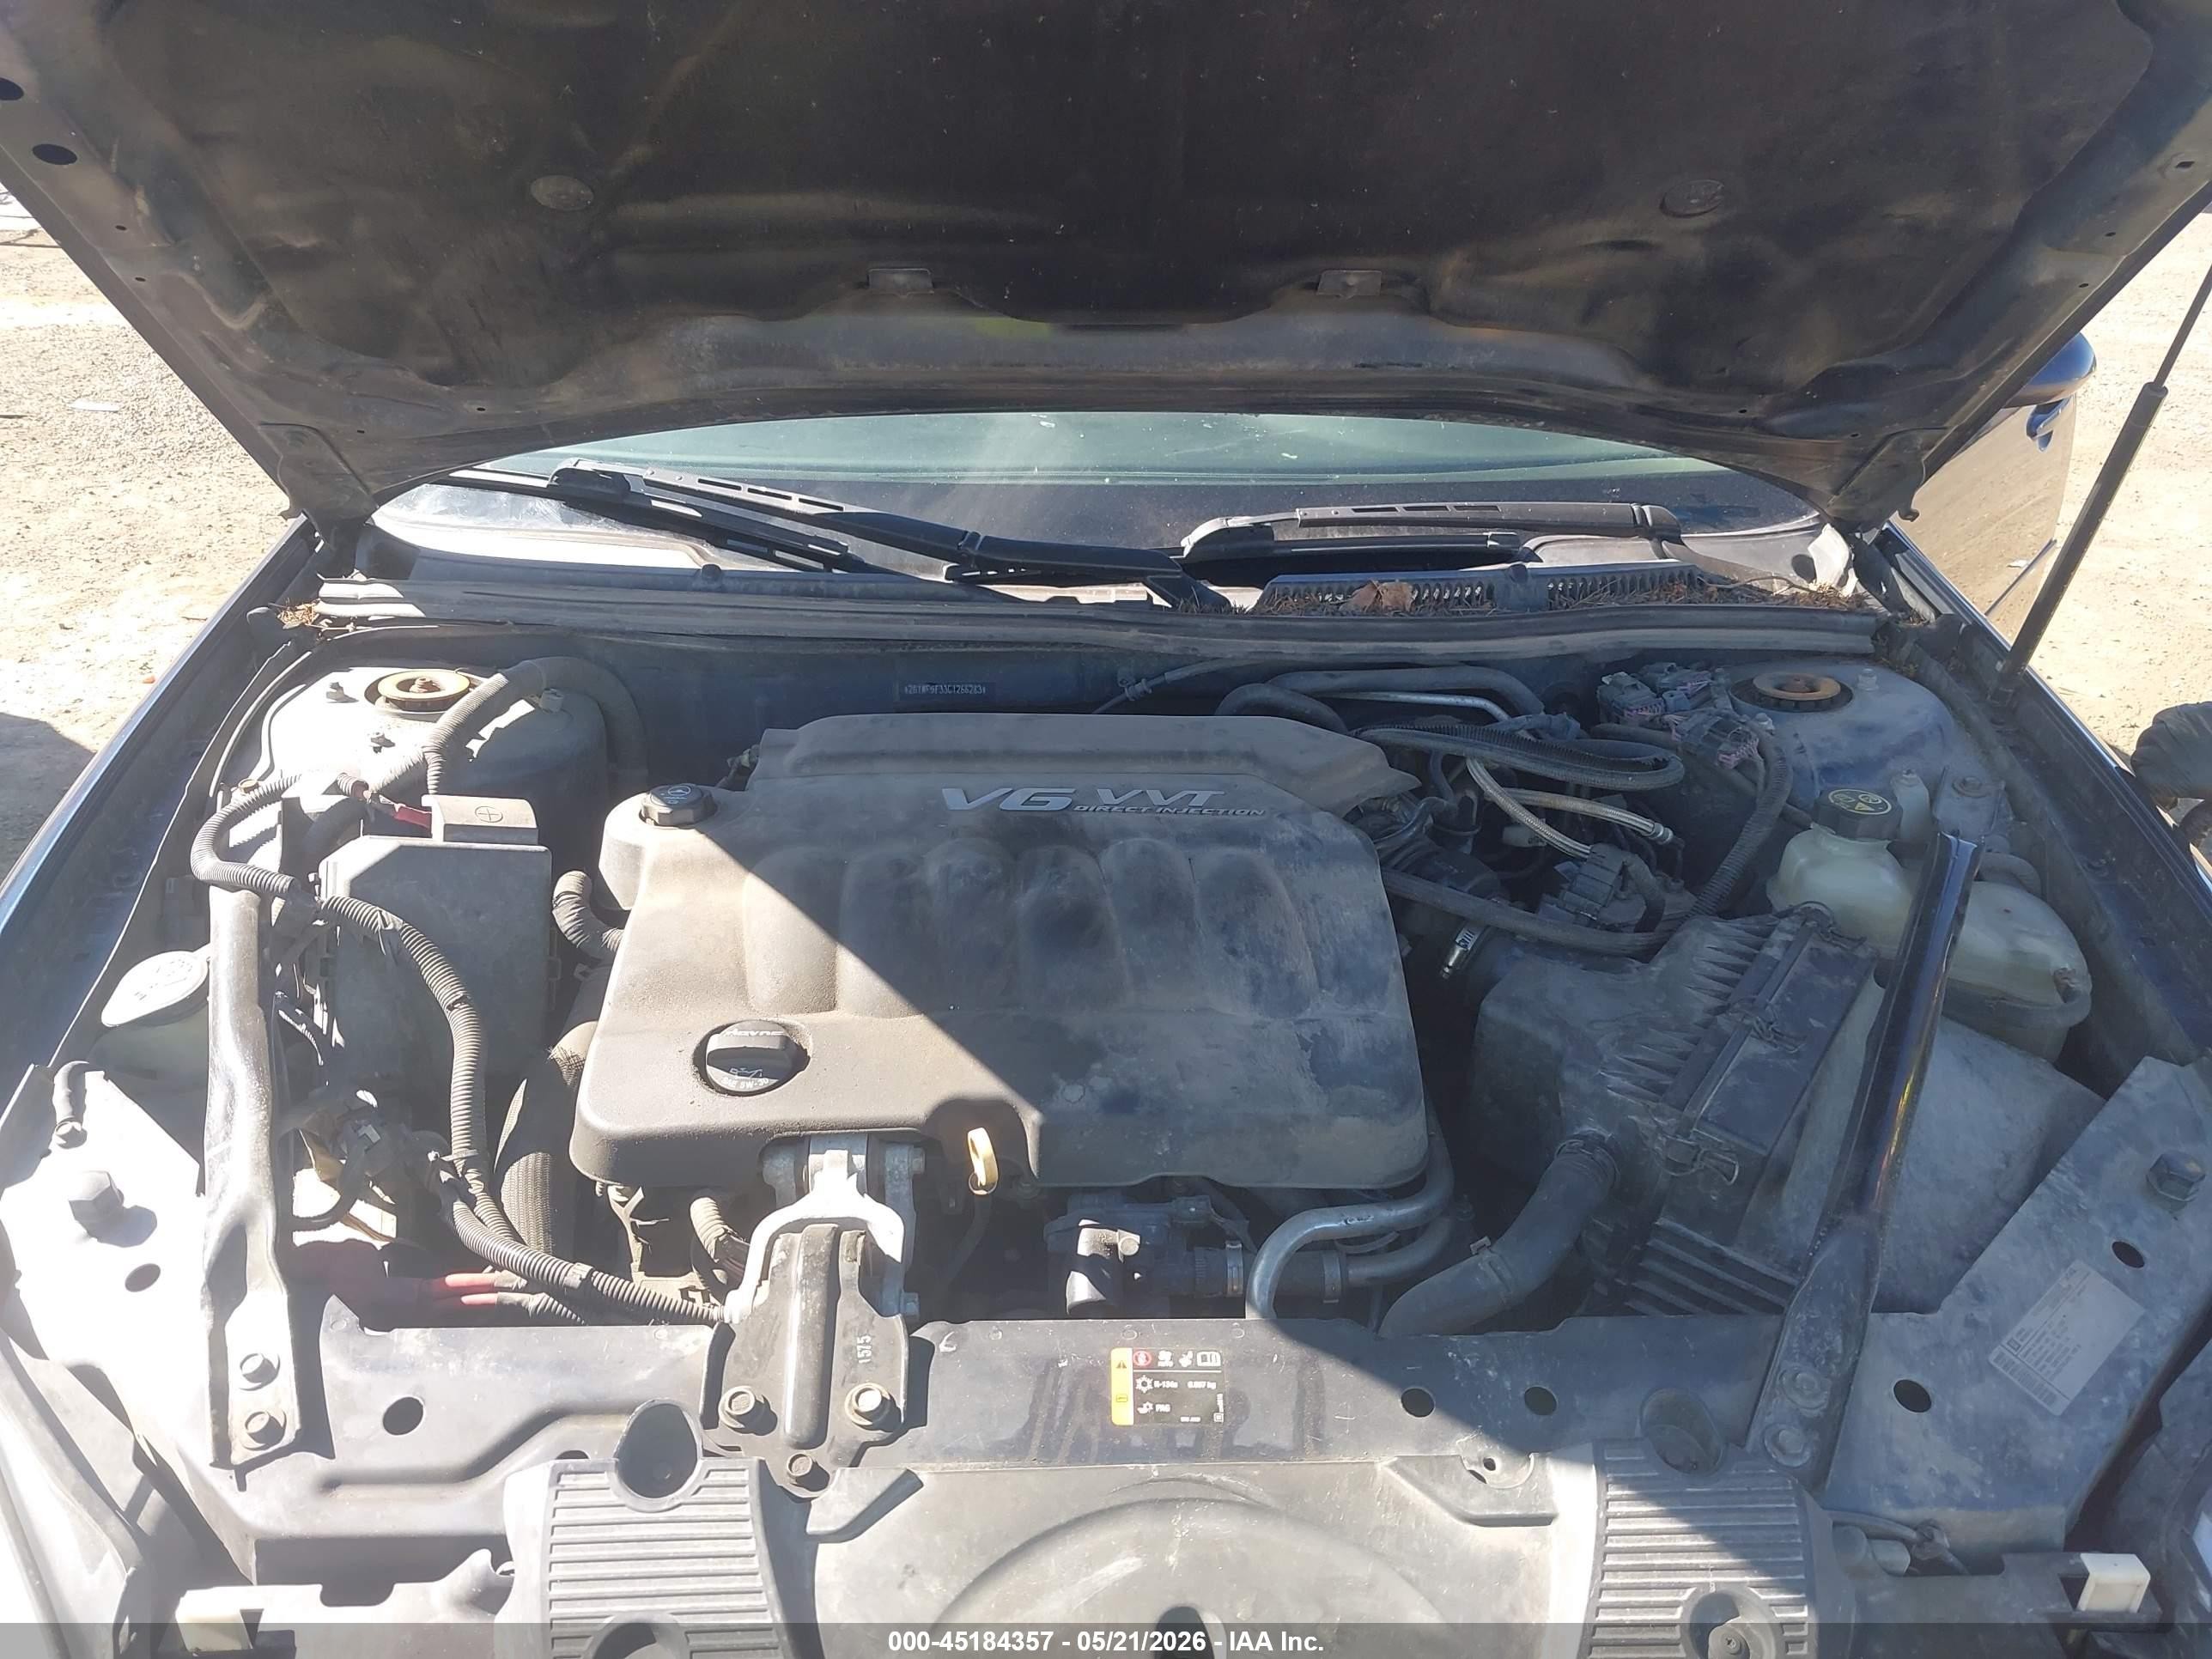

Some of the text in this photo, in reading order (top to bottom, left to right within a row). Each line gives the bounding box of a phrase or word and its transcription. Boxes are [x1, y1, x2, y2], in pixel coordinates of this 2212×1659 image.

[942, 787, 1224, 811] V6 VVT
[1073, 805, 1265, 817] DIRECT INJECTION
[720, 1077, 769, 1089] SAE 5W-30
[857, 1335, 872, 1364] 1575
[1154, 1380, 1178, 1389] R-134a
